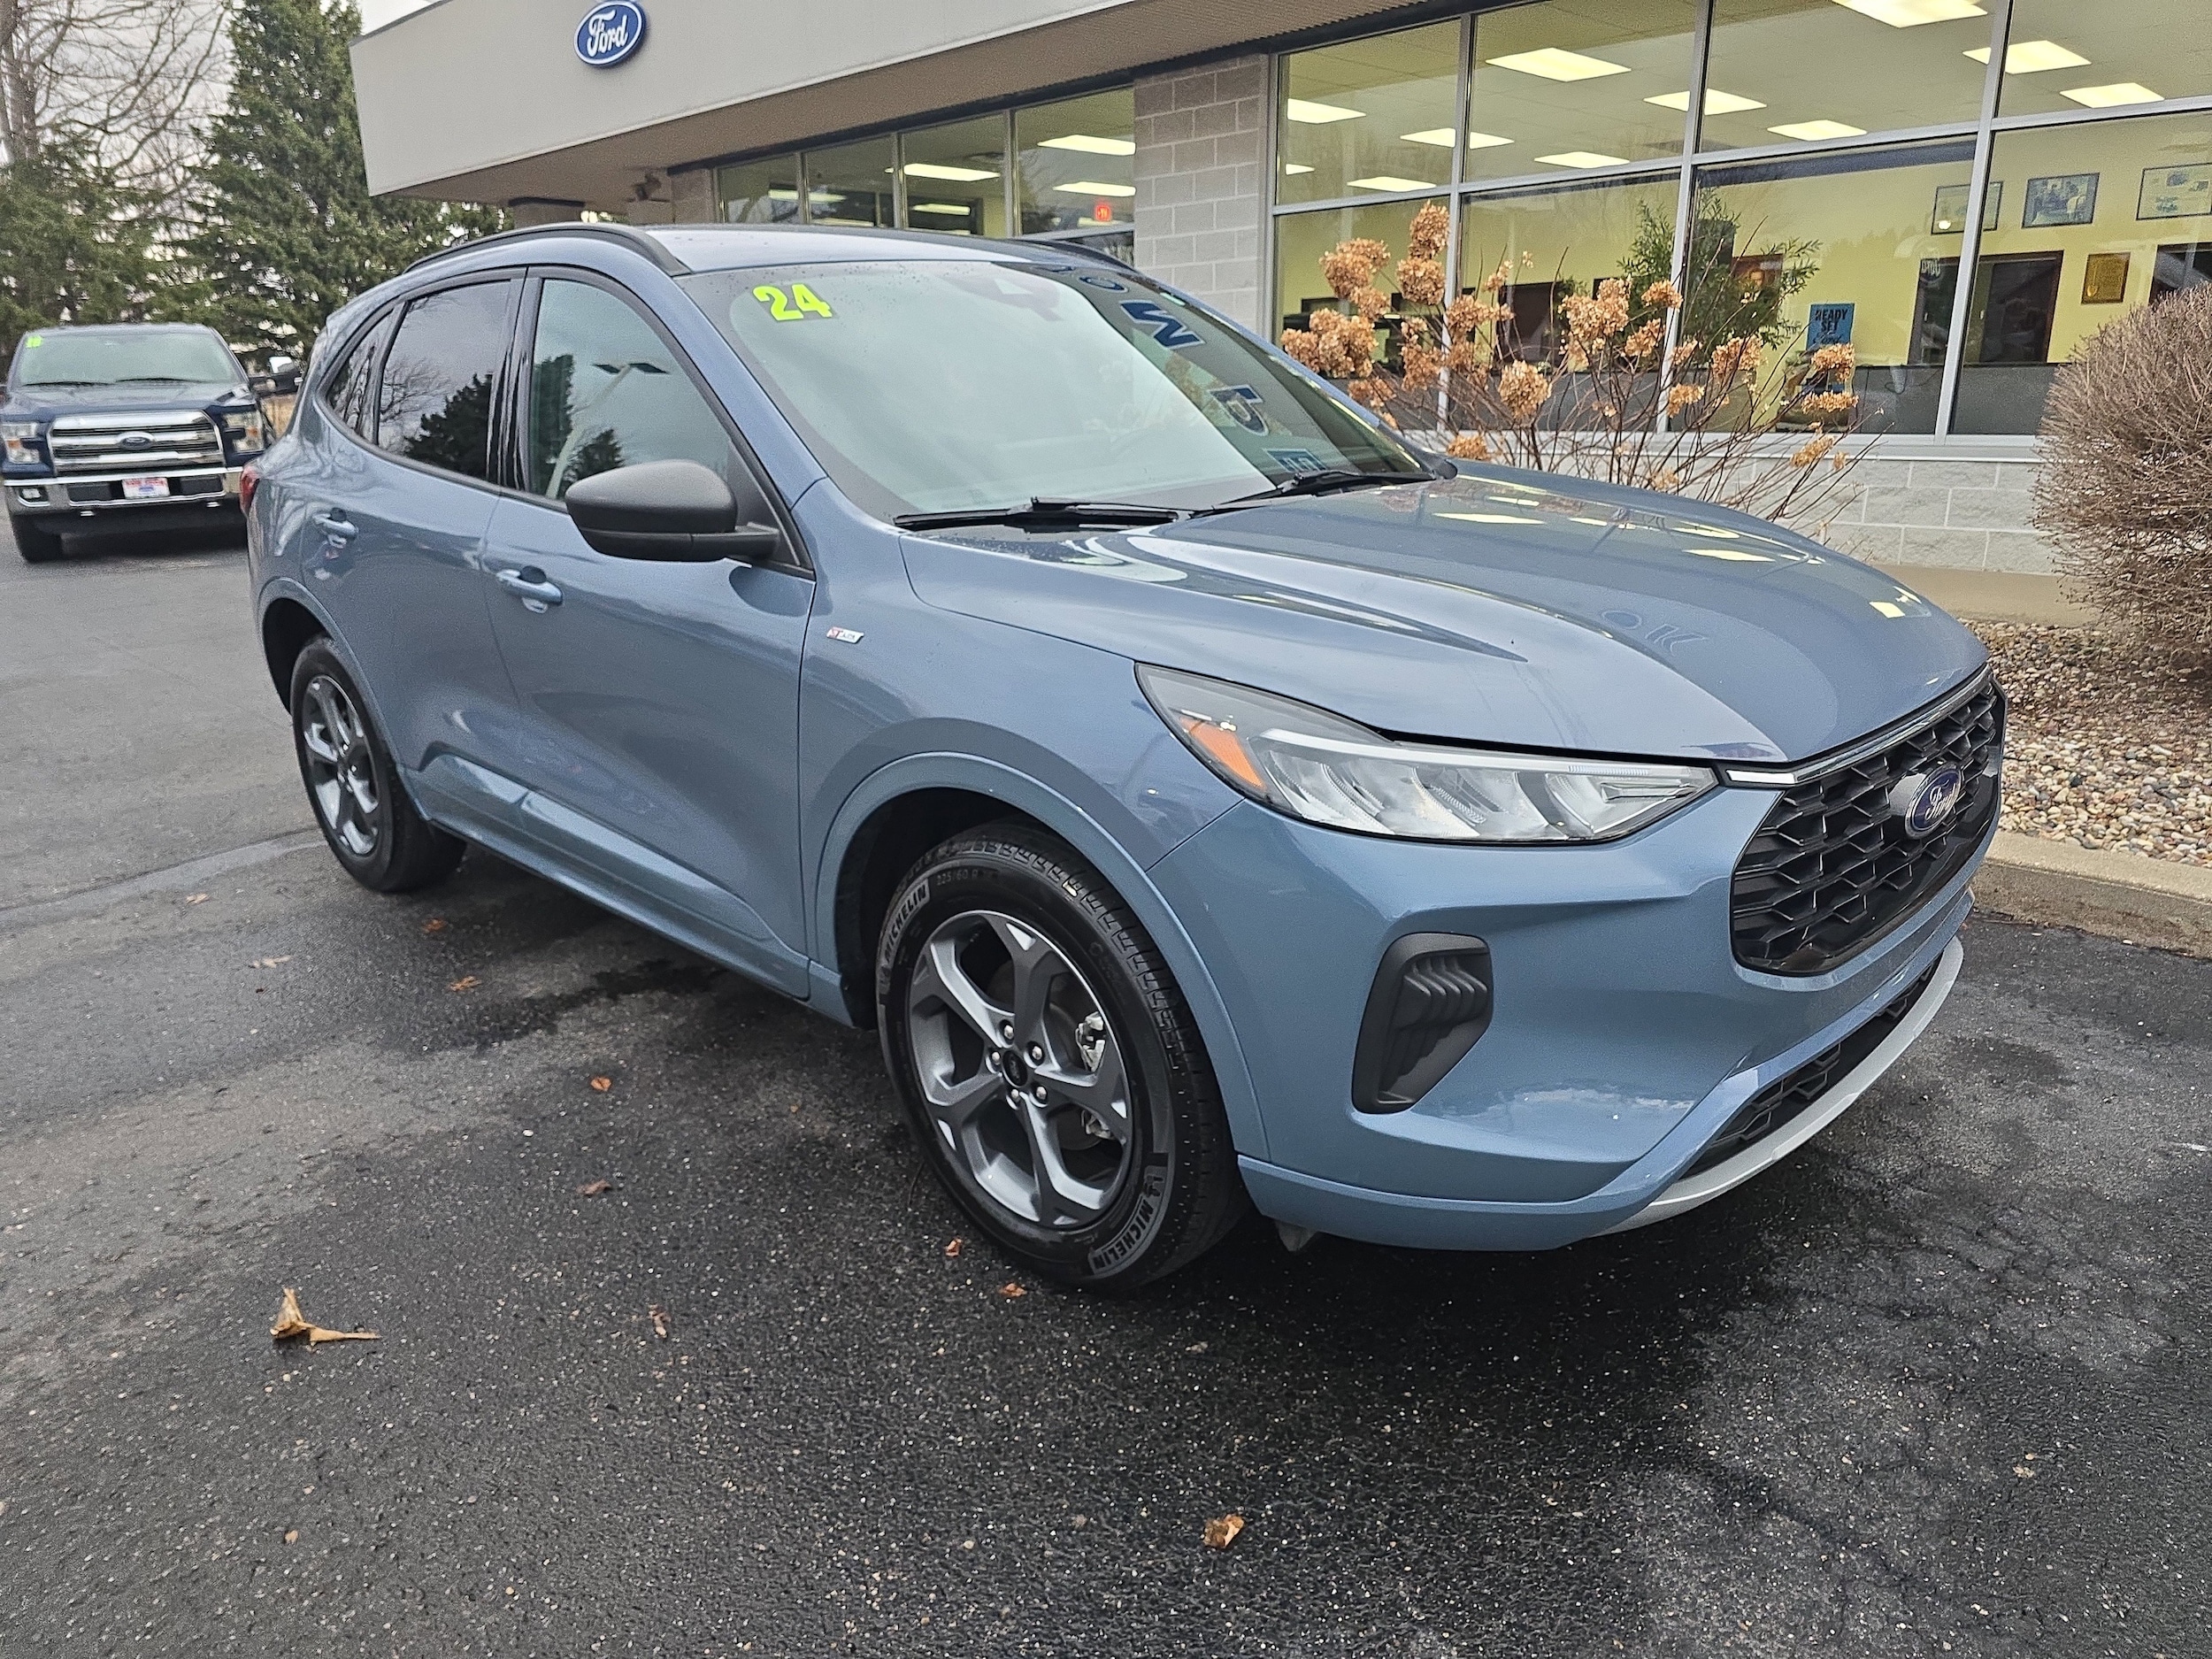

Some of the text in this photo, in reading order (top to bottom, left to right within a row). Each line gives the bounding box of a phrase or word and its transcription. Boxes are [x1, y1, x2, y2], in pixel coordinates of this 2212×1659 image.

[587, 9, 629, 57] Ford
[752, 283, 833, 321] 24
[1815, 309, 1847, 320] READY
[1821, 319, 1839, 332] SET
[1924, 779, 1957, 821] Ford
[884, 883, 927, 964] MICHELIN
[1092, 1199, 1155, 1270] MICHELIN
